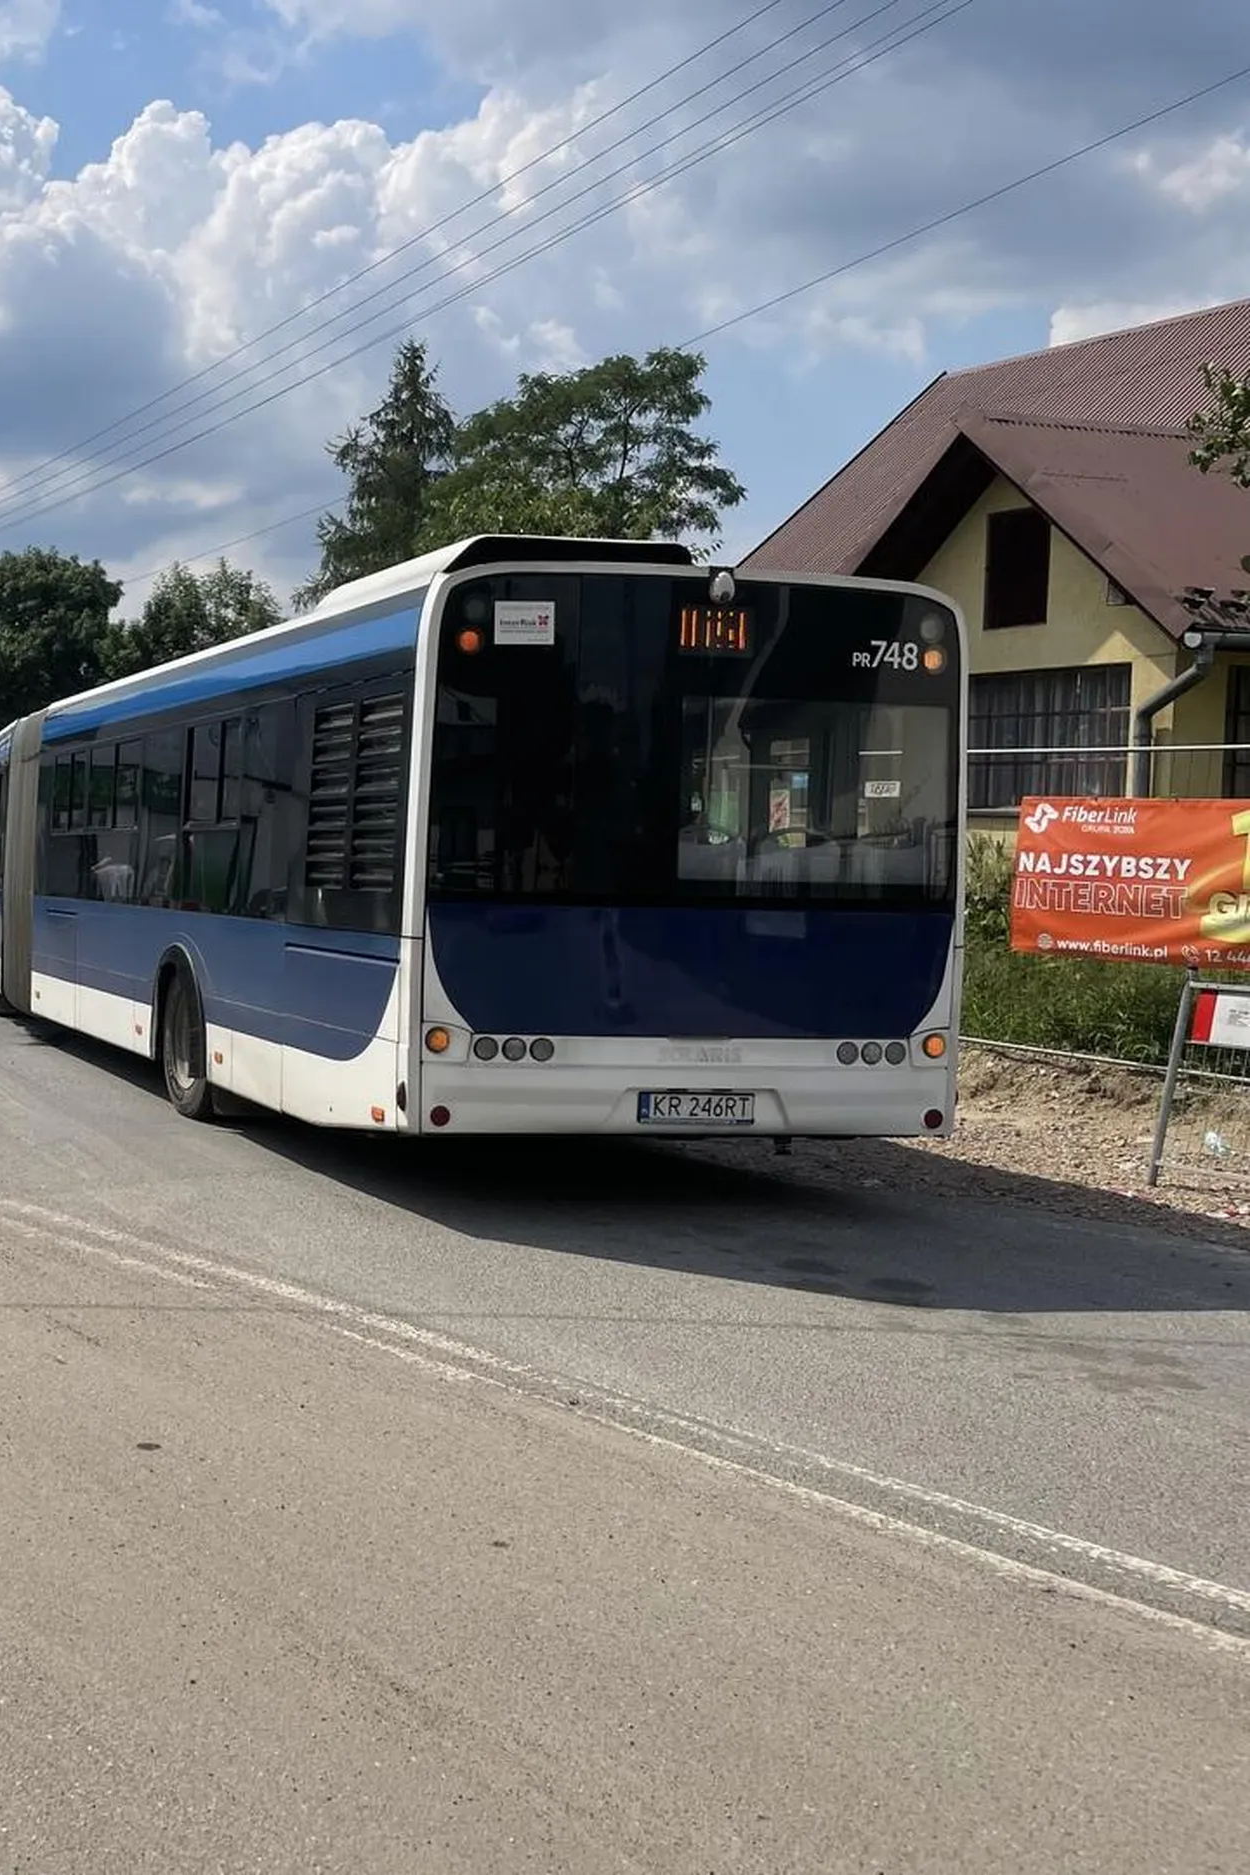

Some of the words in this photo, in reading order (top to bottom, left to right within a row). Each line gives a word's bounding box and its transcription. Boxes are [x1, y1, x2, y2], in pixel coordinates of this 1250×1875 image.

[1062, 806, 1137, 823] FiberLink
[1018, 852, 1191, 880] NAJSZYBSZY
[1015, 878, 1188, 919] INTERNET
[1056, 939, 1168, 958] www.fiberlink.pl
[1205, 950, 1222, 963] 12
[653, 1096, 681, 1116] KR
[690, 1096, 750, 1117] 246RT
